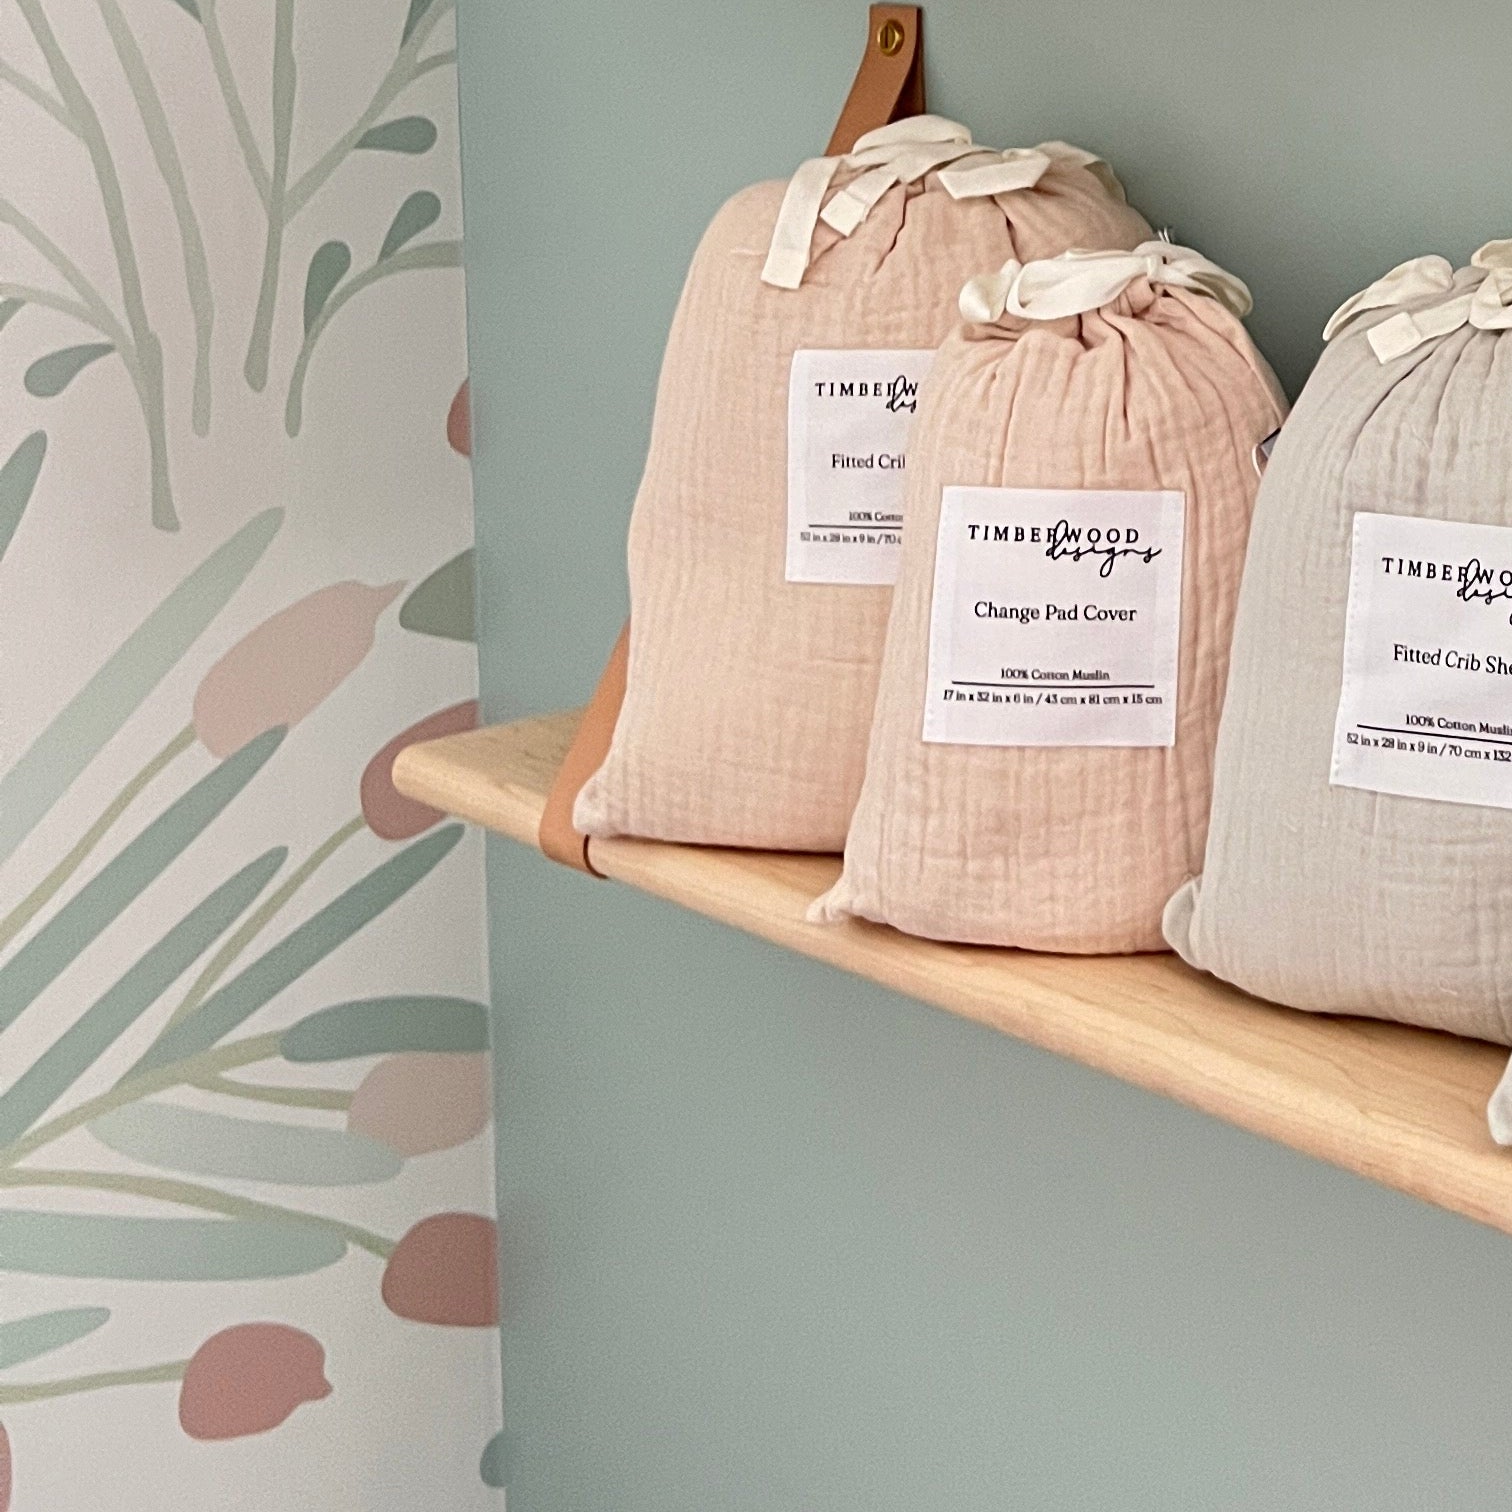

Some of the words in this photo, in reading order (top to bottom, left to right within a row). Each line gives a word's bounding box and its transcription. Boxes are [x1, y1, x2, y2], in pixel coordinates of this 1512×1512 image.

[832, 454, 873, 468] Fitted
[1045, 520, 1162, 577] designs
[975, 601, 1039, 623] Change
[1046, 604, 1077, 620] Pad
[1084, 605, 1137, 621] Cover
[1394, 644, 1441, 665] Fitted
[1446, 651, 1480, 671] Crib
[1001, 668, 1028, 679] 100%
[1031, 669, 1069, 680] Cotton
[1072, 670, 1109, 680] Muslin
[943, 689, 955, 701] 17
[955, 690, 967, 702] in
[968, 693, 975, 702] x
[991, 692, 1003, 704] in
[1005, 695, 1011, 703] x
[1022, 693, 1035, 705] in
[1044, 693, 1058, 705] 43
[1059, 696, 1078, 705] cm
[1080, 696, 1087, 705] x
[1102, 696, 1121, 705] cm
[1122, 696, 1129, 705] x
[1144, 696, 1163, 705] cm
[1406, 714, 1435, 727] 100%
[1438, 718, 1476, 732] Cotton
[1360, 734, 1372, 747] in
[1372, 738, 1380, 748] x
[1381, 736, 1395, 749] 28
[1396, 738, 1408, 751] in
[1409, 742, 1416, 752] x
[1417, 740, 1426, 753] 9
[1426, 742, 1438, 755] in
[1448, 744, 1463, 757] 70
[1463, 749, 1482, 760] cm
[1483, 750, 1491, 761] x
[1493, 749, 1512, 763] 132
